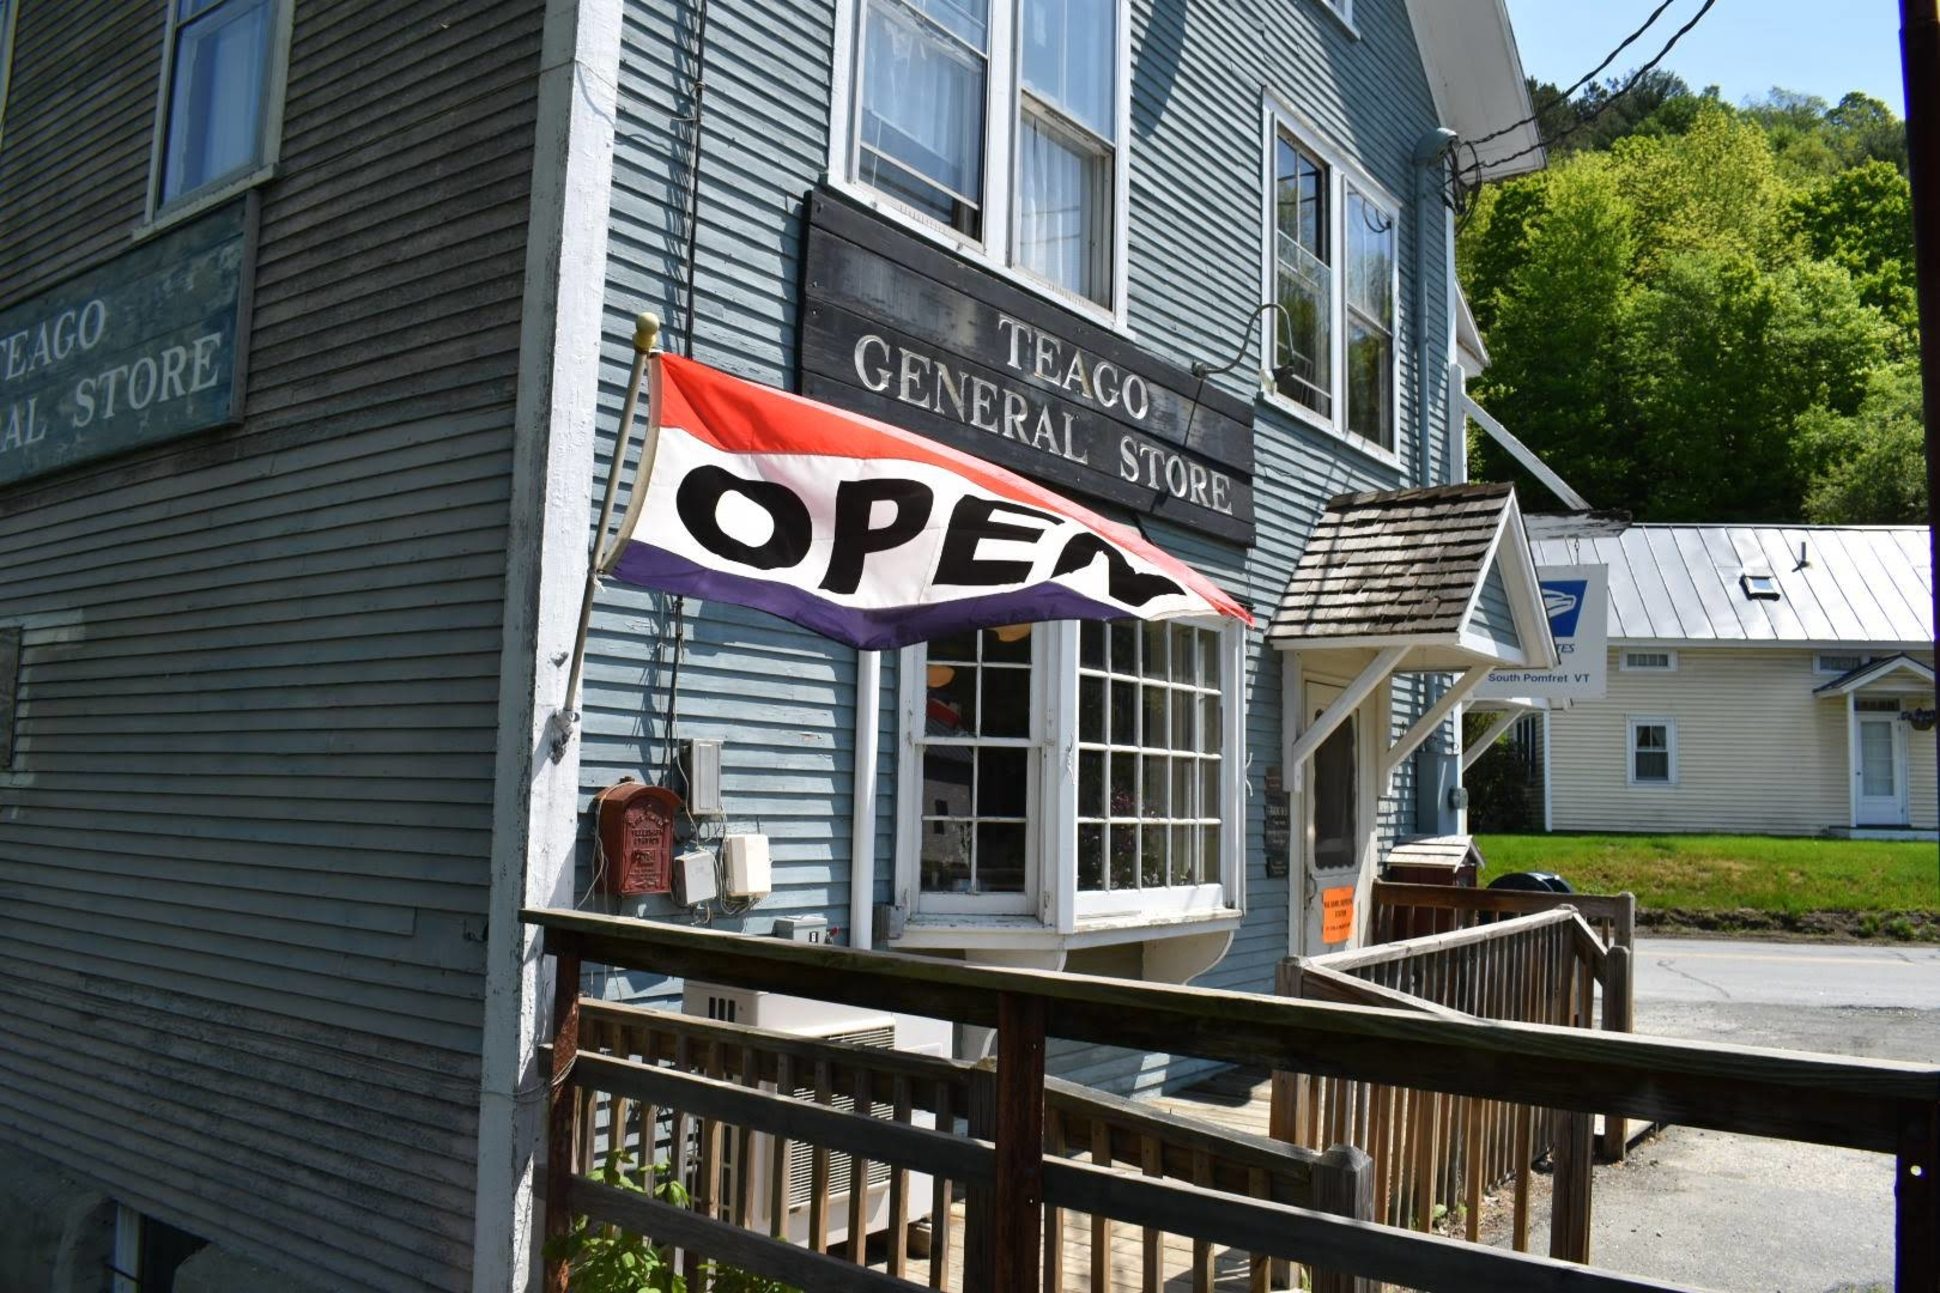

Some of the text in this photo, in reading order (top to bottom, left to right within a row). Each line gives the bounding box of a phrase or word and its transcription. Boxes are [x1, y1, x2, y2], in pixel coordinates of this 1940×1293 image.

[0, 299, 106, 382] EAGO
[72, 332, 222, 428] STORE
[999, 316, 1149, 420] TEAGO
[853, 333, 1233, 516] GENERAL STORE
[1488, 673, 1590, 683] South Pomfret VT
